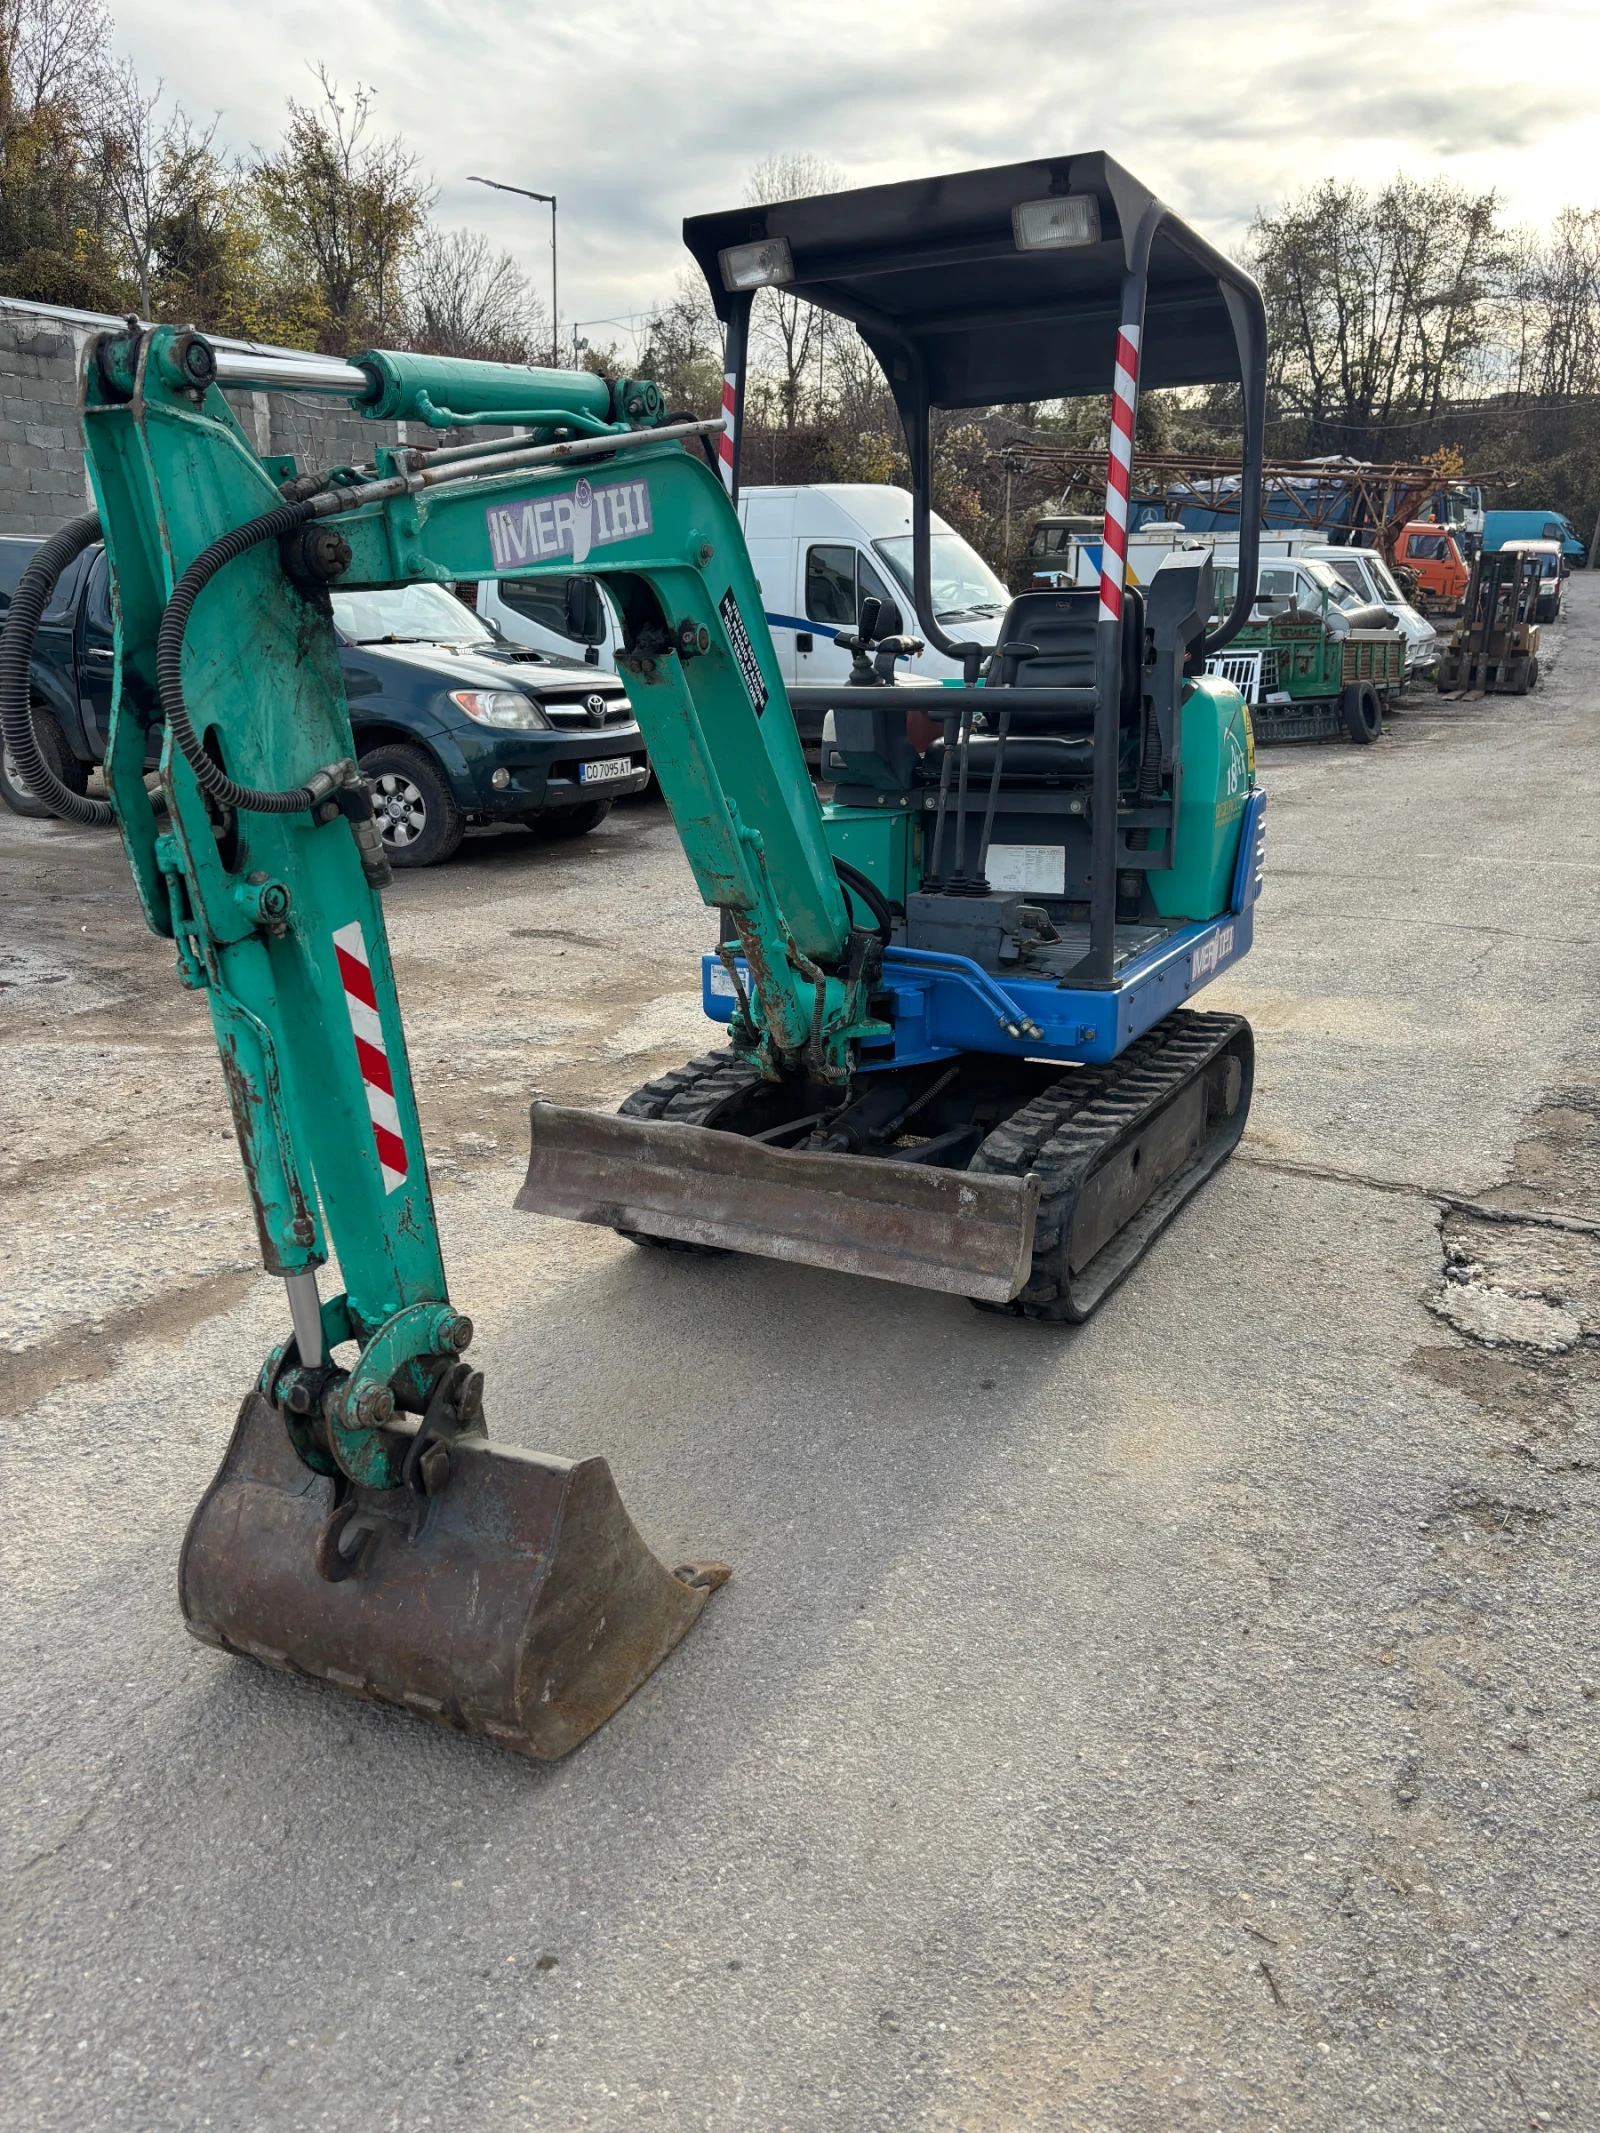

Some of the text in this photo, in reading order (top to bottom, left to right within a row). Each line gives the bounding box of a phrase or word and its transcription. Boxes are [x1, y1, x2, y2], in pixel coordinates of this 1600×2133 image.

[490, 483, 649, 564] IMER IHI
[723, 597, 765, 708] NEL RAGGIO D'AZIONE
[731, 600, 765, 691] VIETATO SOSTARE
[599, 762, 619, 777] 7095
[620, 761, 629, 774] AT
